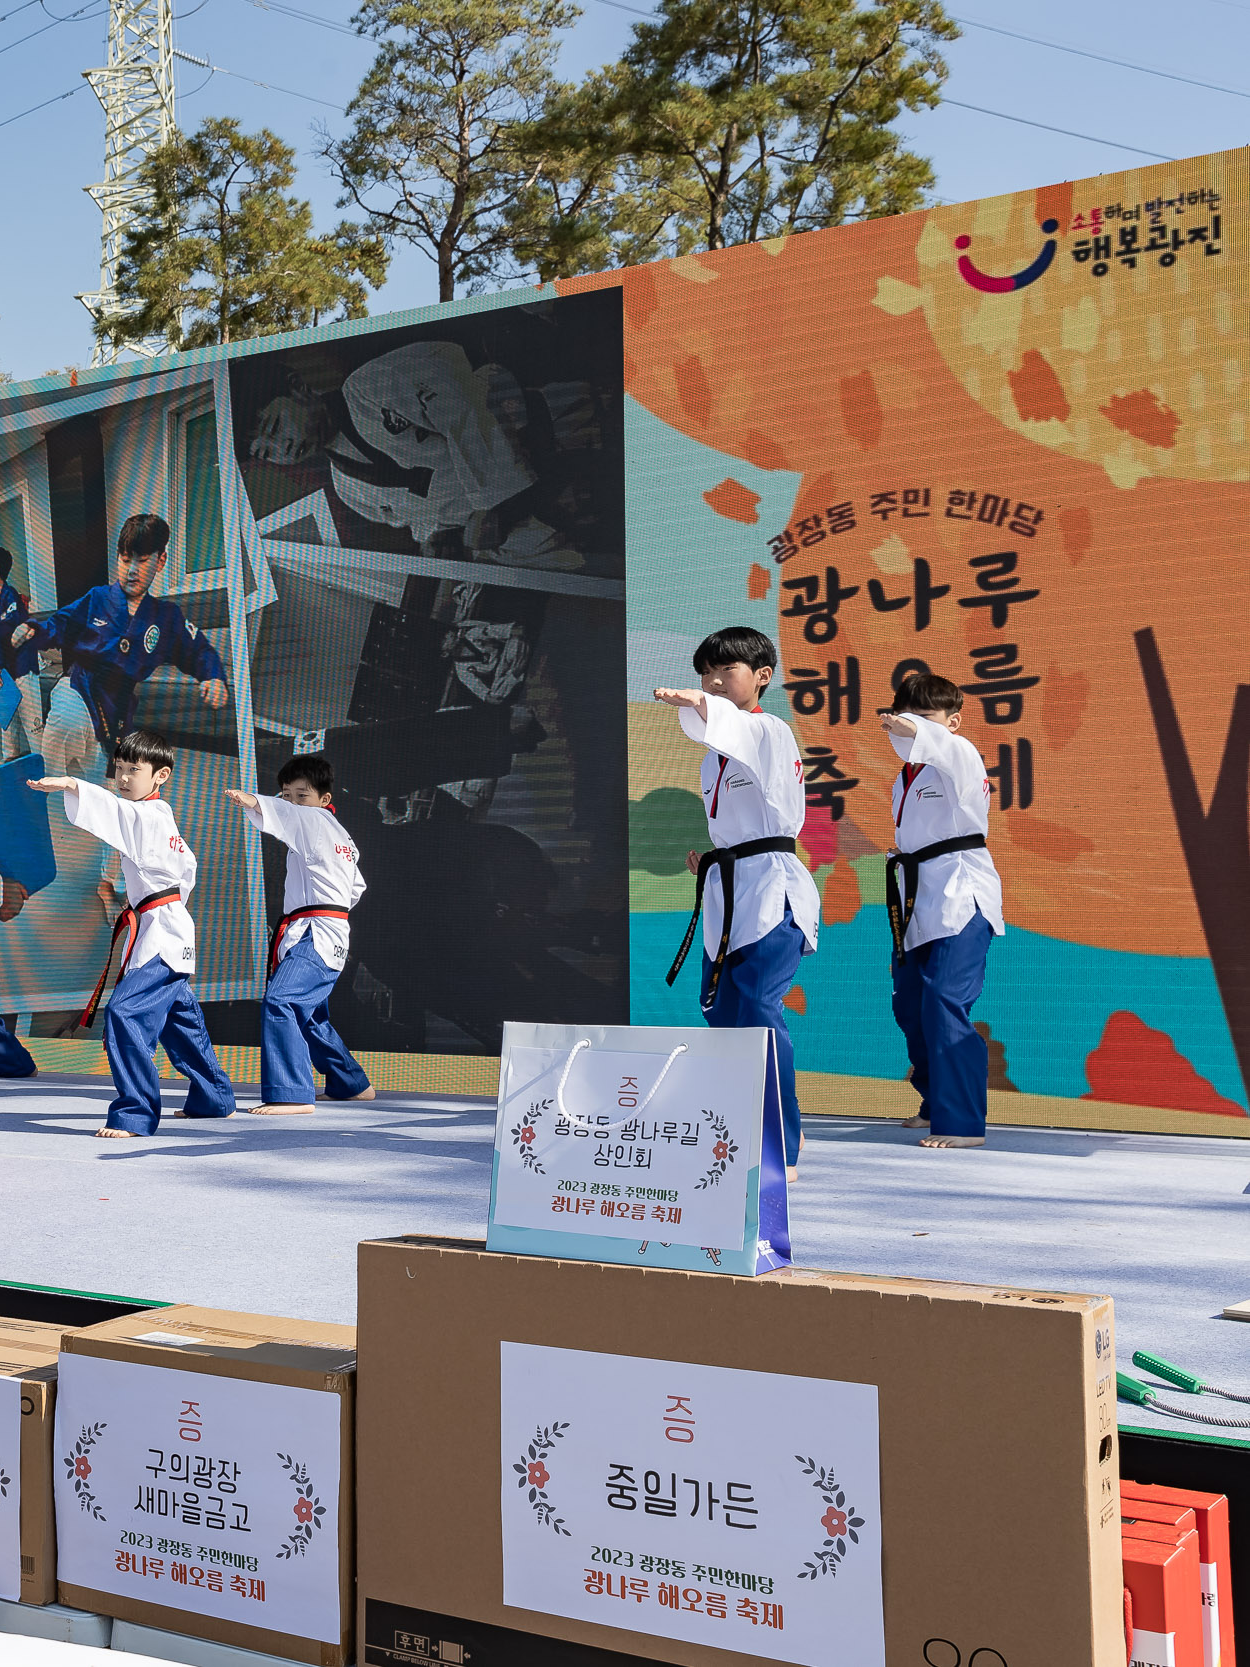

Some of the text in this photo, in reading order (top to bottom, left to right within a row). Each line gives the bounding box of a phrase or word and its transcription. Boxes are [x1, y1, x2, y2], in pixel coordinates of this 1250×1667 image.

[1072, 214, 1222, 277] 행복광진
[766, 488, 1044, 564] 광장동 주민 한마당
[780, 552, 1040, 644] 광나루
[617, 1076, 640, 1108] 증
[593, 1143, 653, 1170] 상인회
[550, 1195, 682, 1225] 광나루 해오름 축제
[557, 1179, 679, 1203] 2023 광장동 주민한마당
[178, 1400, 203, 1443] 증
[662, 1394, 696, 1444] 증
[145, 1448, 241, 1495] 구의광장
[134, 1485, 252, 1533] 새마을금고
[605, 1463, 759, 1530] 중일가든
[120, 1529, 259, 1573] 2023 광장동 주민한마당
[590, 1545, 775, 1595] 2023 광장동 주민한마당
[114, 1549, 266, 1602] 광나루 해오름 축제
[582, 1568, 785, 1631] 광나루 해오름 축제
[399, 1633, 426, 1654] 후면
